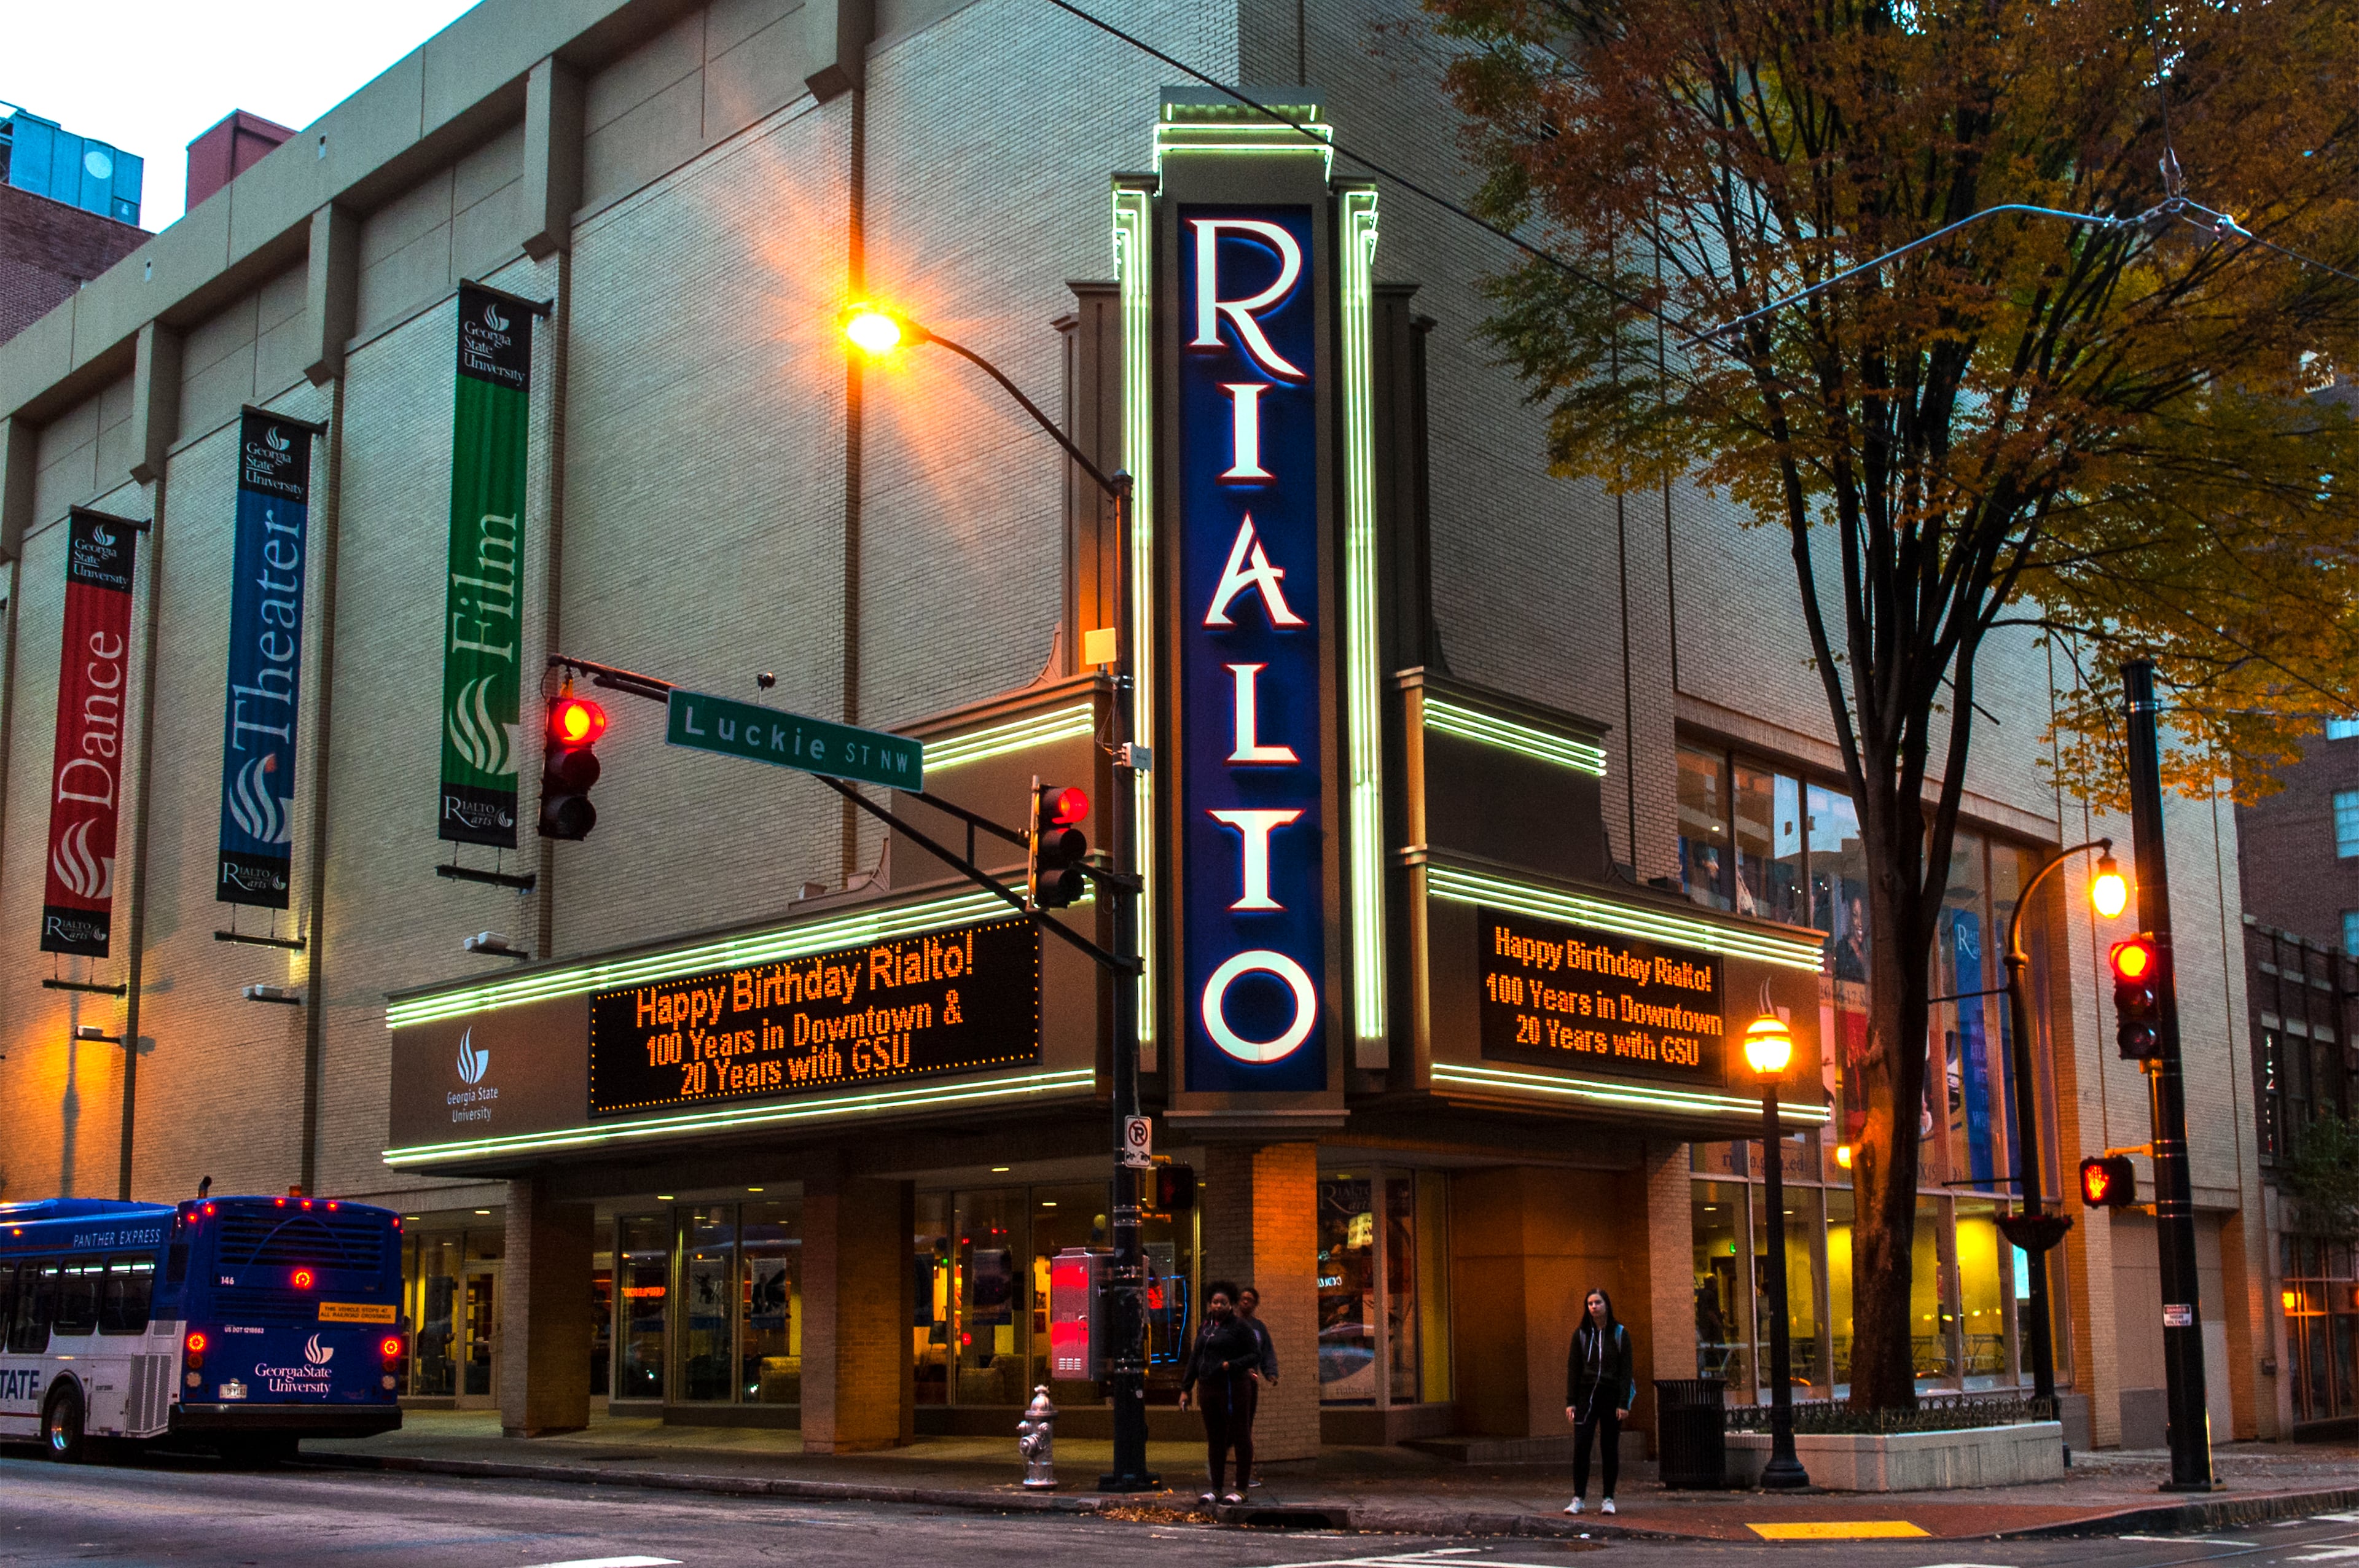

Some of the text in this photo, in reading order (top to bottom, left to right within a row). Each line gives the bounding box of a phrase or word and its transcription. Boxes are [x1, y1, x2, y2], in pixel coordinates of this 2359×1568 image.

[464, 320, 511, 348] Georgia
[464, 335, 493, 354] State
[464, 353, 525, 386] University
[246, 442, 292, 466] Georgia
[246, 454, 274, 471] State
[246, 470, 304, 498] University
[74, 550, 100, 564] State
[75, 538, 117, 560] Georgia
[74, 563, 128, 590] University
[452, 512, 517, 663] Film
[232, 509, 301, 752] Theater
[1184, 218, 1318, 1064] RIALTO
[58, 631, 123, 810] Dance
[685, 706, 908, 773] Luckie ST NW
[442, 795, 495, 828] RIALTO
[471, 817, 492, 826] arts
[222, 862, 270, 891] RIALTO
[46, 916, 91, 942] RIALTO
[1495, 926, 1712, 993] Happy Birthday Rialto!
[636, 932, 973, 1029] Happy Birthday Rialto!
[1486, 972, 1723, 1036] 100 Years in Downtown
[647, 989, 963, 1067] 100 Years in Downtown &
[1516, 1014, 1699, 1066] 20 Years with GSU
[680, 1033, 910, 1095] 20 Years with GSU
[447, 1086, 499, 1106] Georgia State
[452, 1106, 491, 1123] University
[73, 1228, 161, 1248] PANTHER EXPRESS
[221, 1276, 234, 1285] 146
[268, 1378, 332, 1398] University
